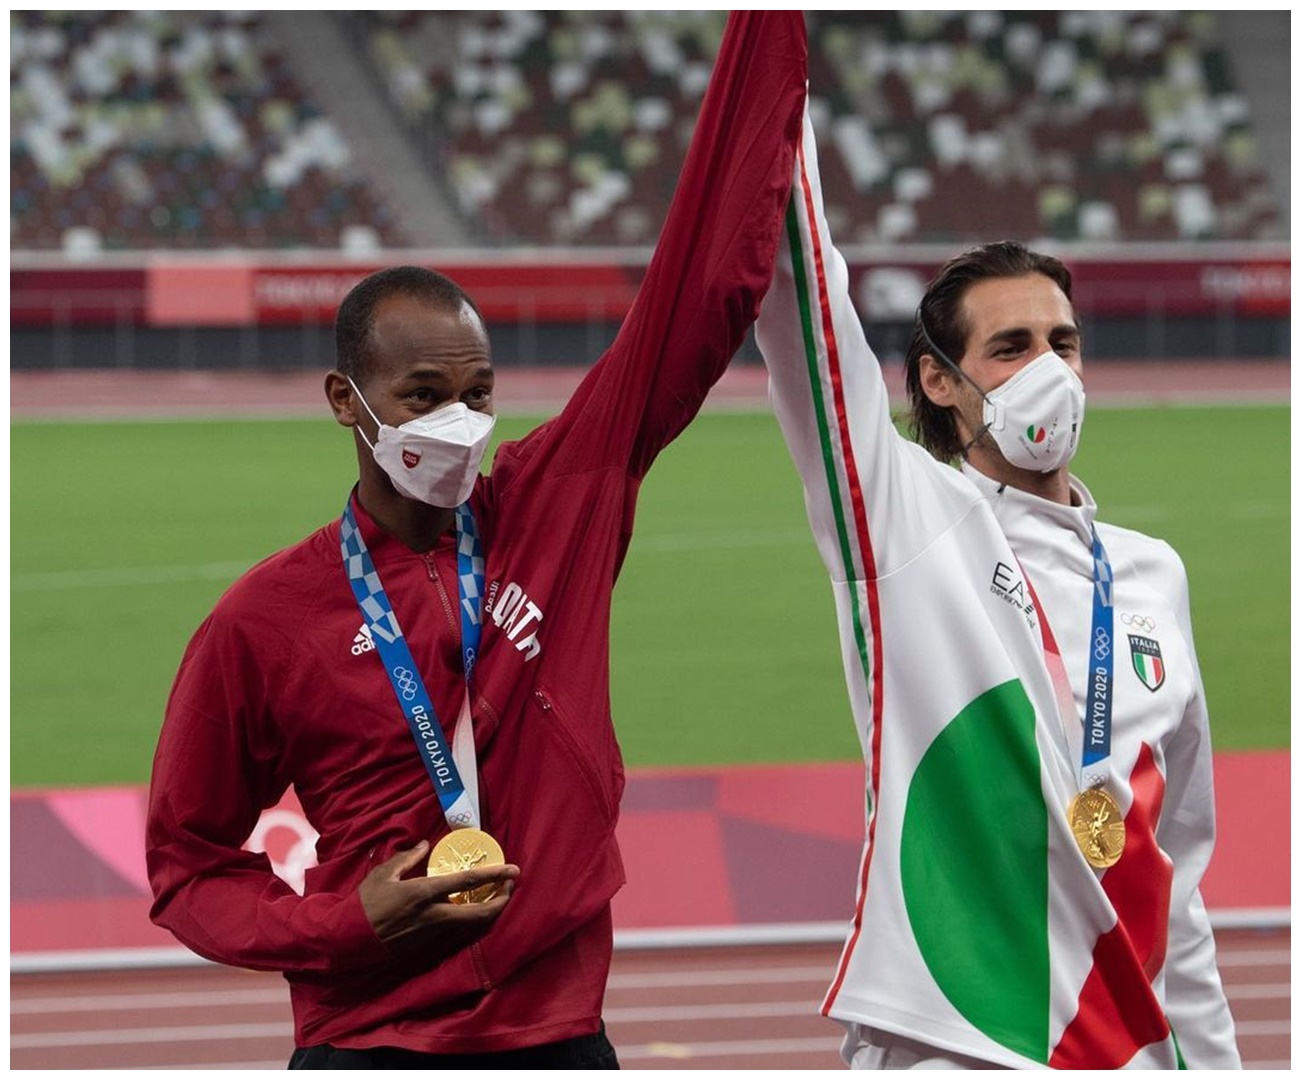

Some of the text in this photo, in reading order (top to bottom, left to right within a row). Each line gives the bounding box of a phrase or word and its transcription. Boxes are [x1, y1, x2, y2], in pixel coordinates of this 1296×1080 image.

[1130, 637, 1158, 650] ITALIA
[1091, 666, 1108, 745] TOKYO 2020
[411, 704, 453, 787] TOKYO 2020
